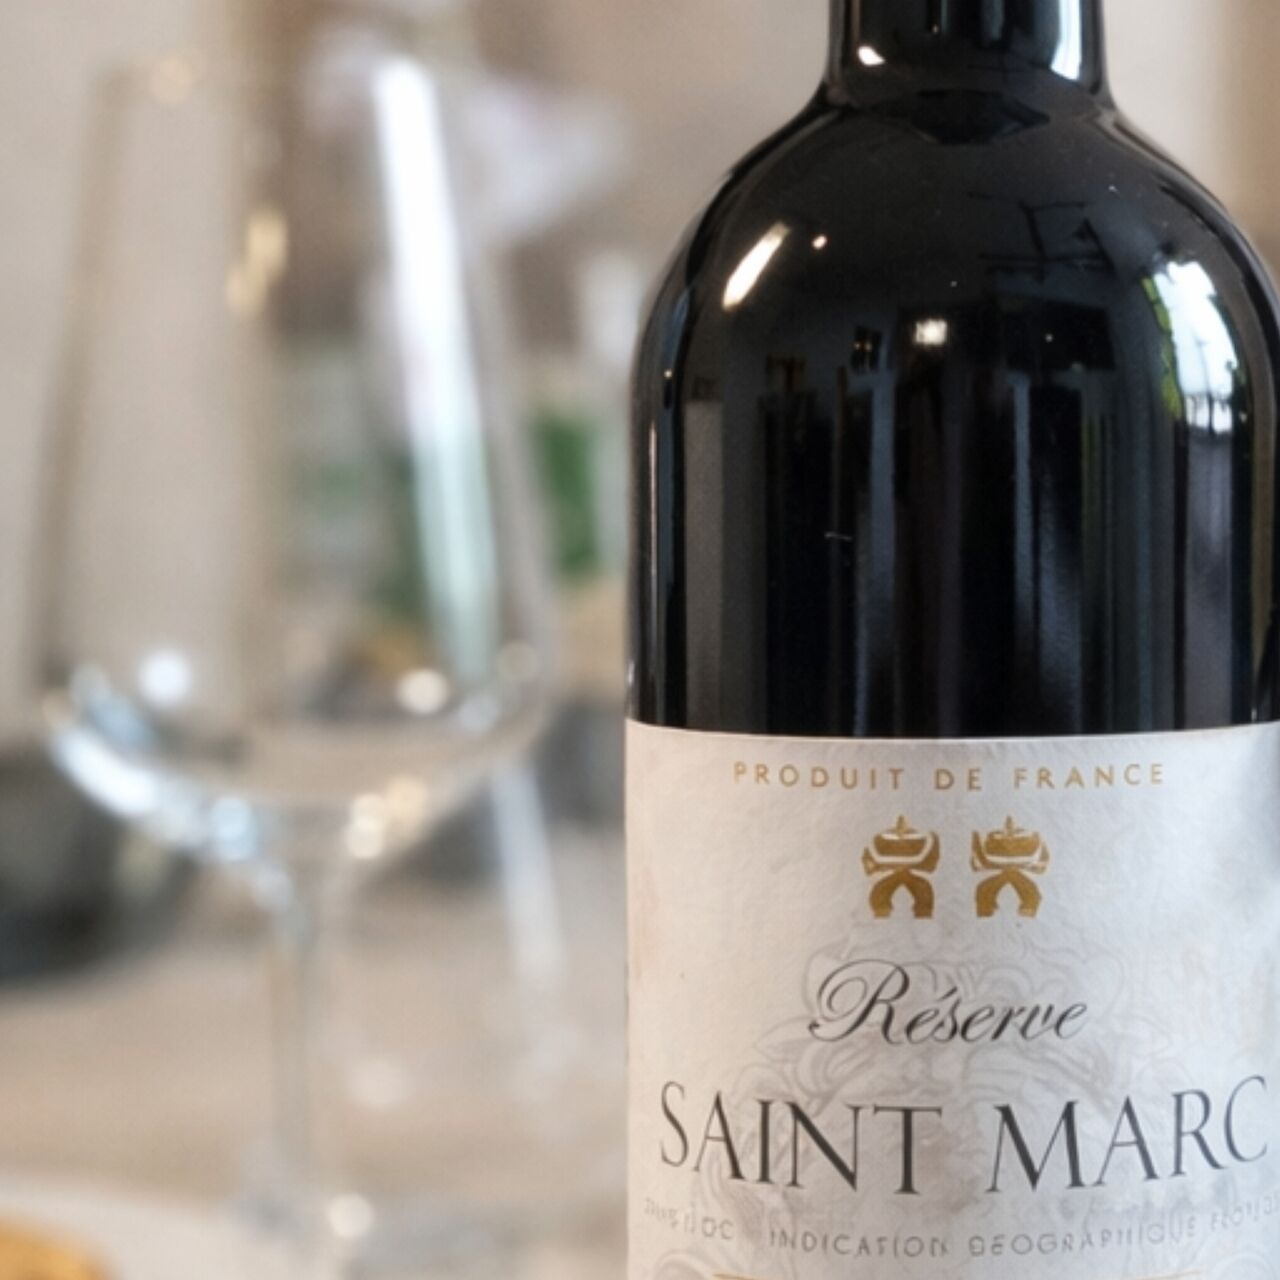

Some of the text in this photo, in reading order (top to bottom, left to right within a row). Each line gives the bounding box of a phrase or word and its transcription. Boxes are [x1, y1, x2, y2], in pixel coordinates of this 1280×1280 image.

[732, 760, 1167, 792] PRODUIT DE FRANCE
[807, 957, 1088, 1046] Réserve
[660, 1075, 1269, 1195] SAINT MARC
[769, 1228, 949, 1258] INDICATION
